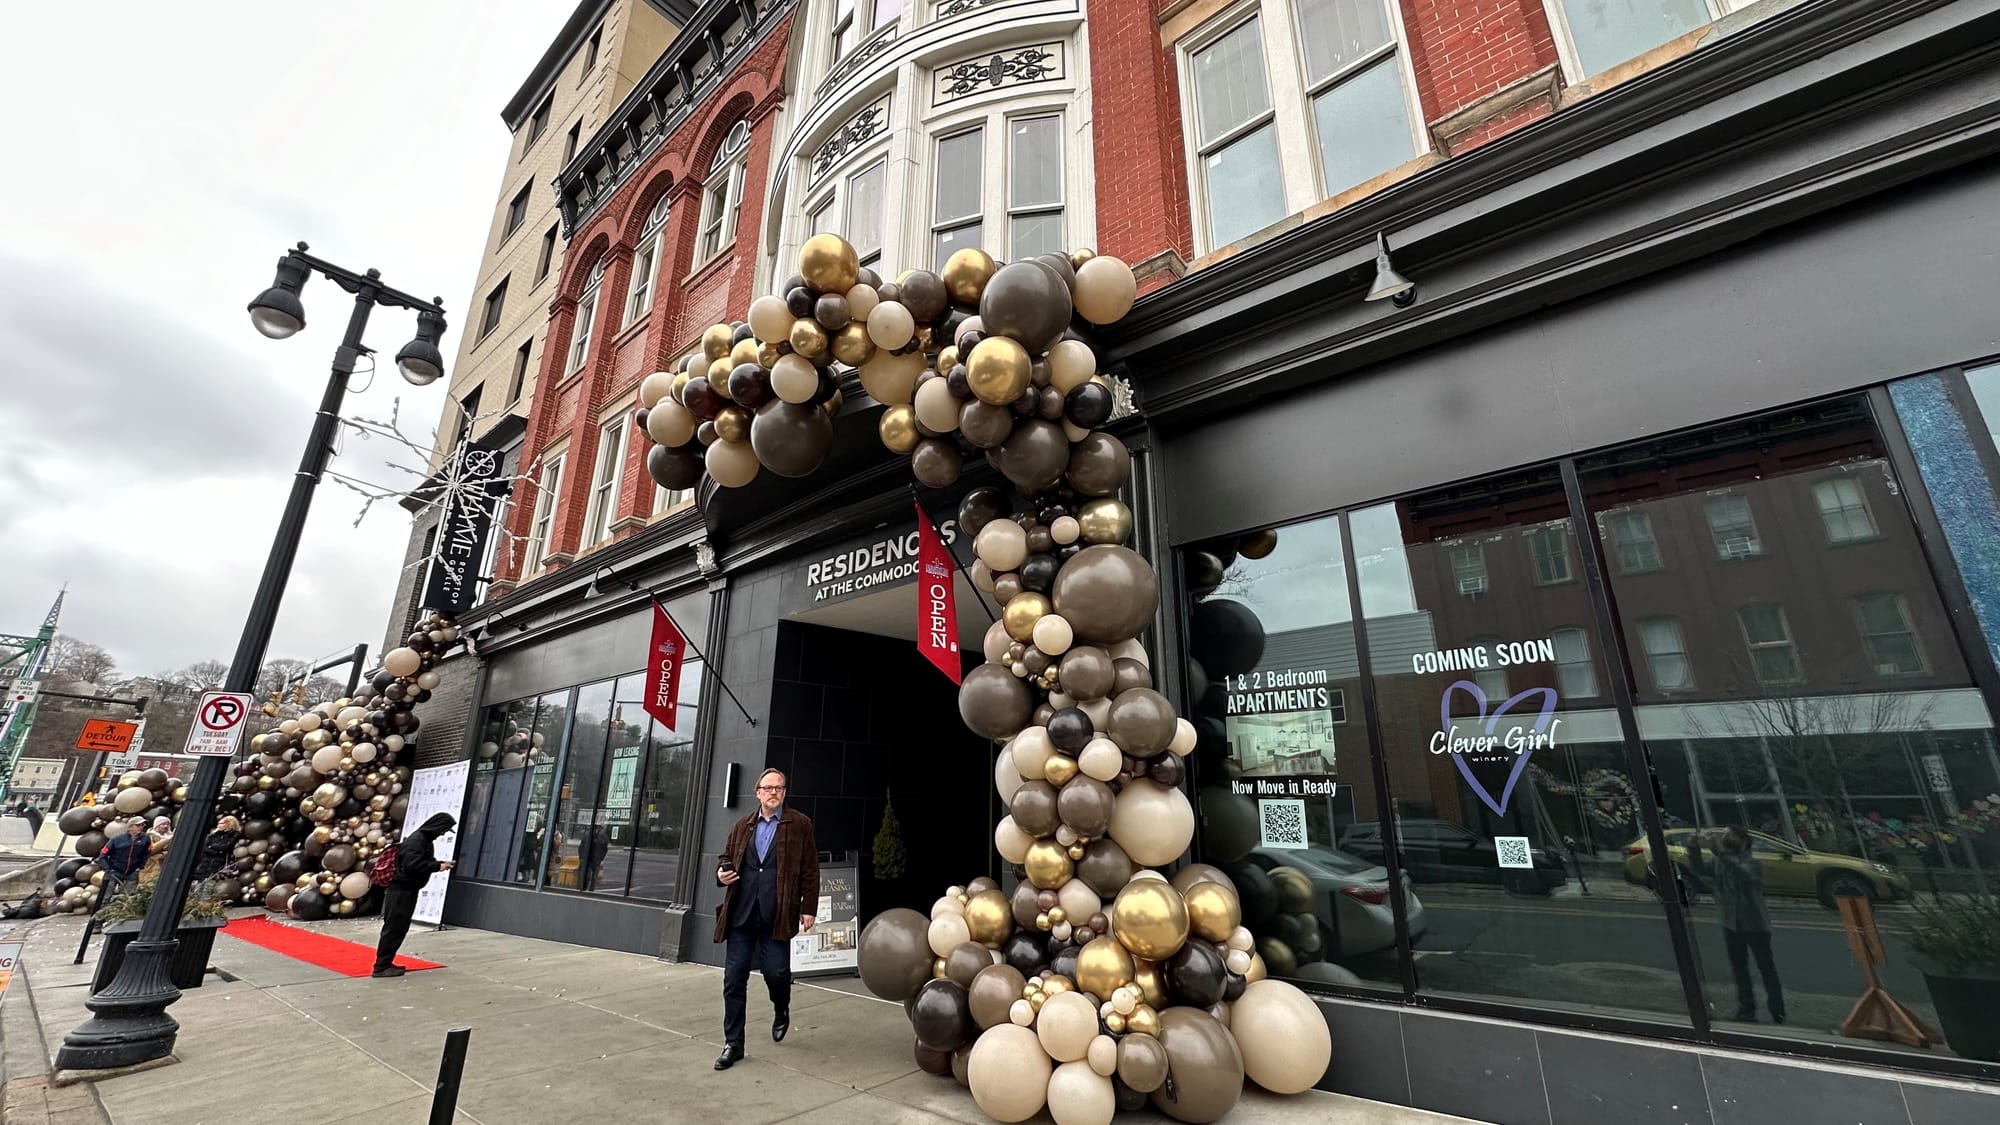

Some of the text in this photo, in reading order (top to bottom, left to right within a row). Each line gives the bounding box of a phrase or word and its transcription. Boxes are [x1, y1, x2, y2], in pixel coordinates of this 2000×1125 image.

[807, 520, 957, 587] RESIDENCS
[815, 586, 828, 601] AT
[831, 580, 853, 596] THE
[855, 560, 920, 590] COMMODO
[930, 584, 948, 649] OPEN
[1412, 638, 1555, 675] COMING SOON
[656, 659, 673, 707] OPEN
[1224, 669, 1328, 692] 1 & 2 Bedroom
[1227, 687, 1329, 714] APARTMENTS
[85, 731, 127, 743] DETOUR
[203, 730, 229, 738] TUESDAY
[1429, 719, 1562, 755] Clever Girl
[111, 758, 133, 766] TONS
[1471, 755, 1510, 763] winery
[1232, 779, 1337, 798] Now Move in Ready
